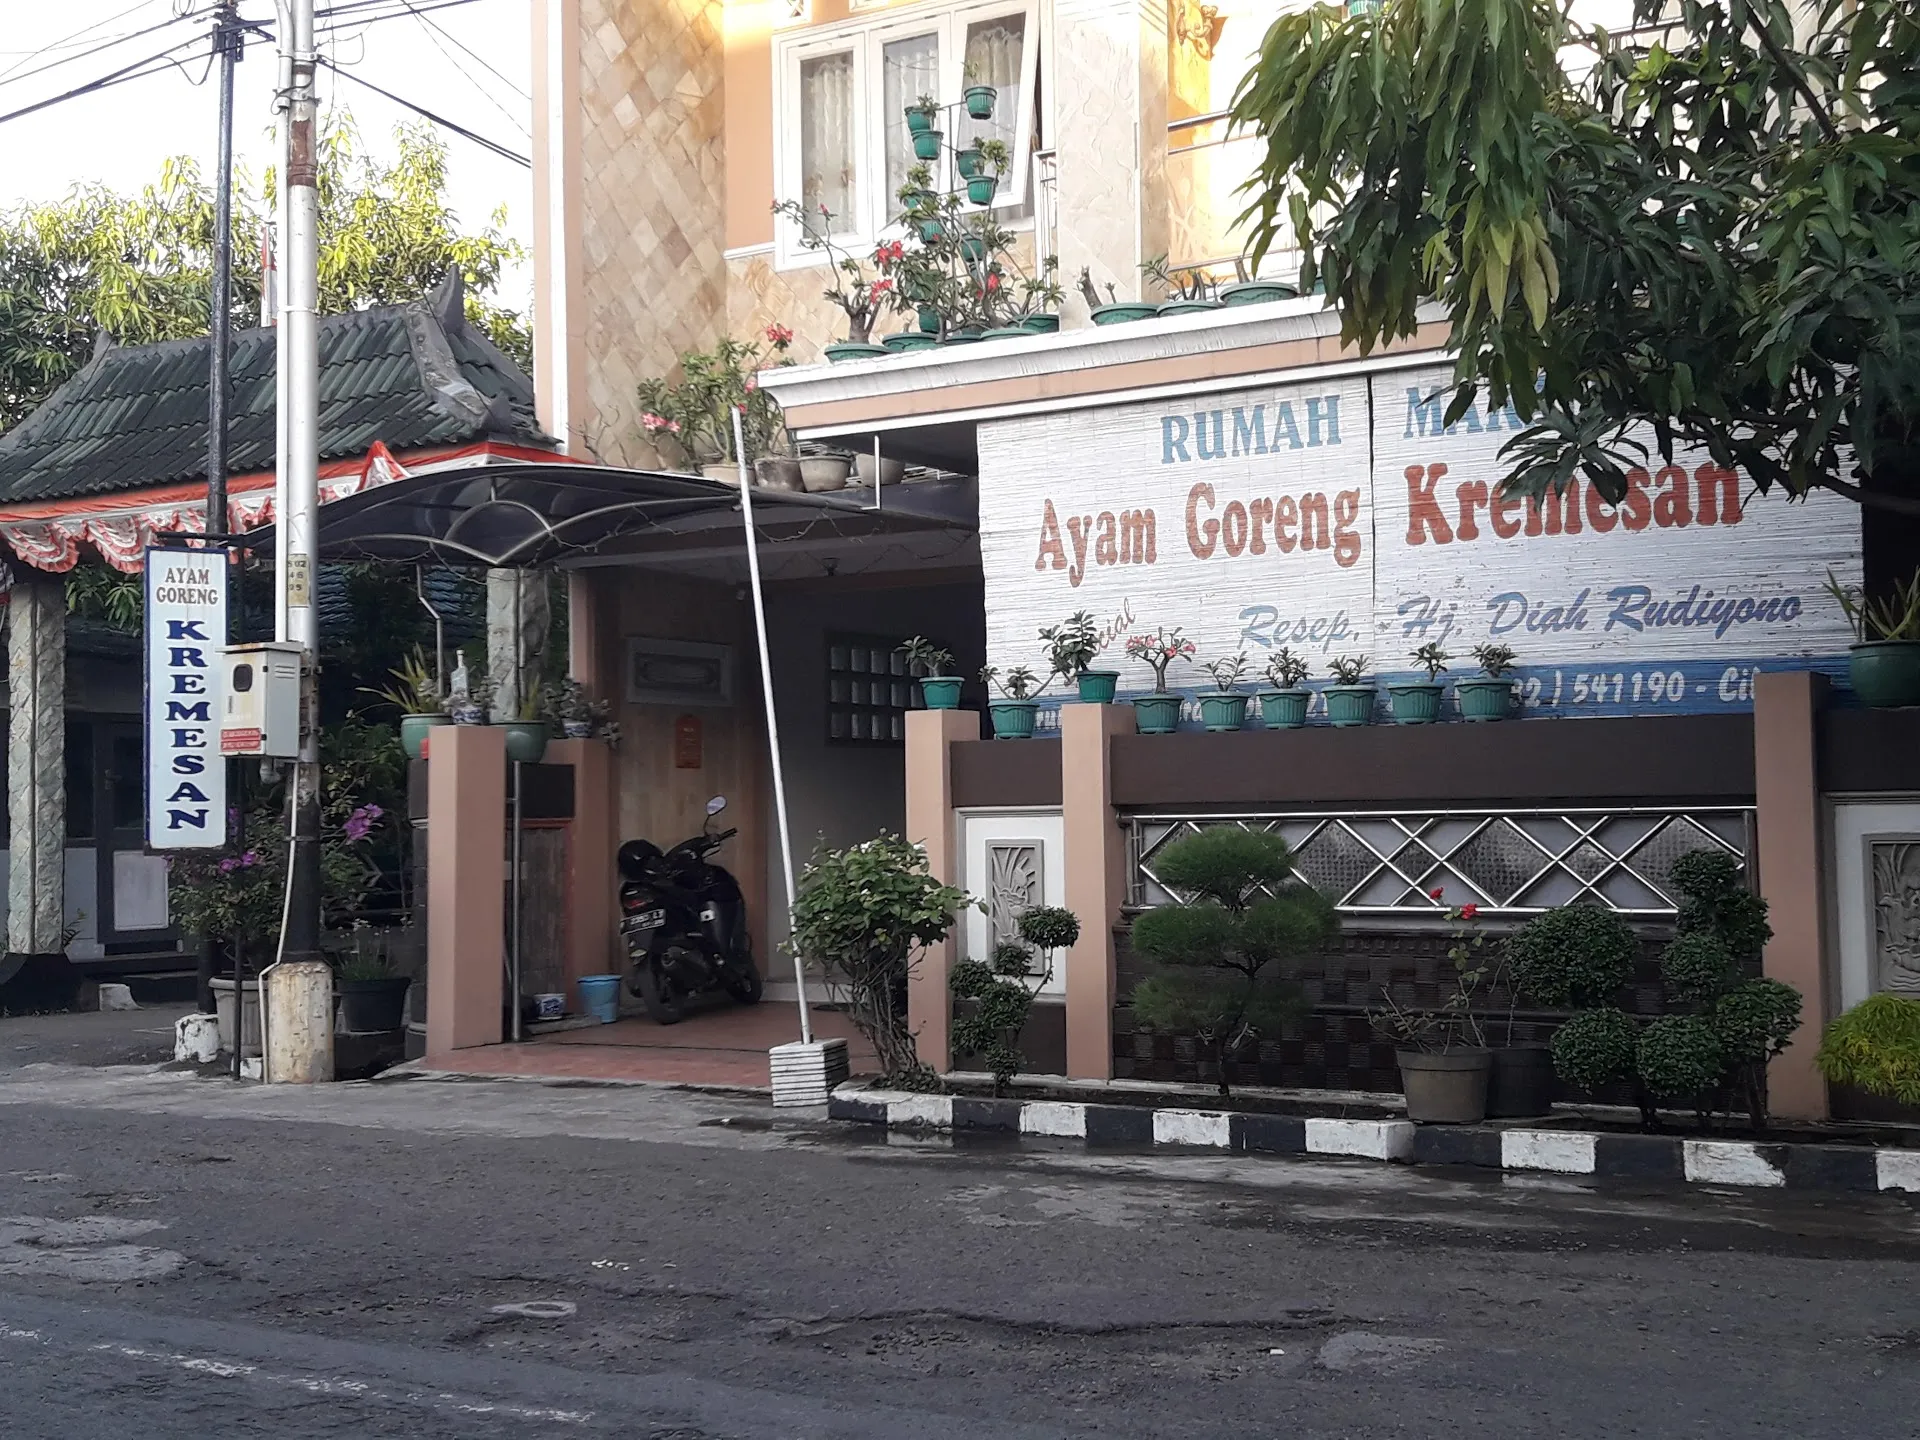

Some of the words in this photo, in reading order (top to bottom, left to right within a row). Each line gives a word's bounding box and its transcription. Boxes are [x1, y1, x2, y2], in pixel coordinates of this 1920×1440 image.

[1160, 395, 1341, 464] RUMAH
[1034, 499, 1157, 588] Ayam
[1185, 482, 1362, 567] Goreng
[1404, 460, 1744, 546] Kremesan
[156, 586, 219, 605] GORENG
[165, 567, 210, 585] AYAM
[1486, 587, 1592, 635] Diah
[1602, 584, 1804, 639] Rudiyono
[1572, 671, 1685, 703] 541190
[165, 619, 211, 829] KREMESAN
